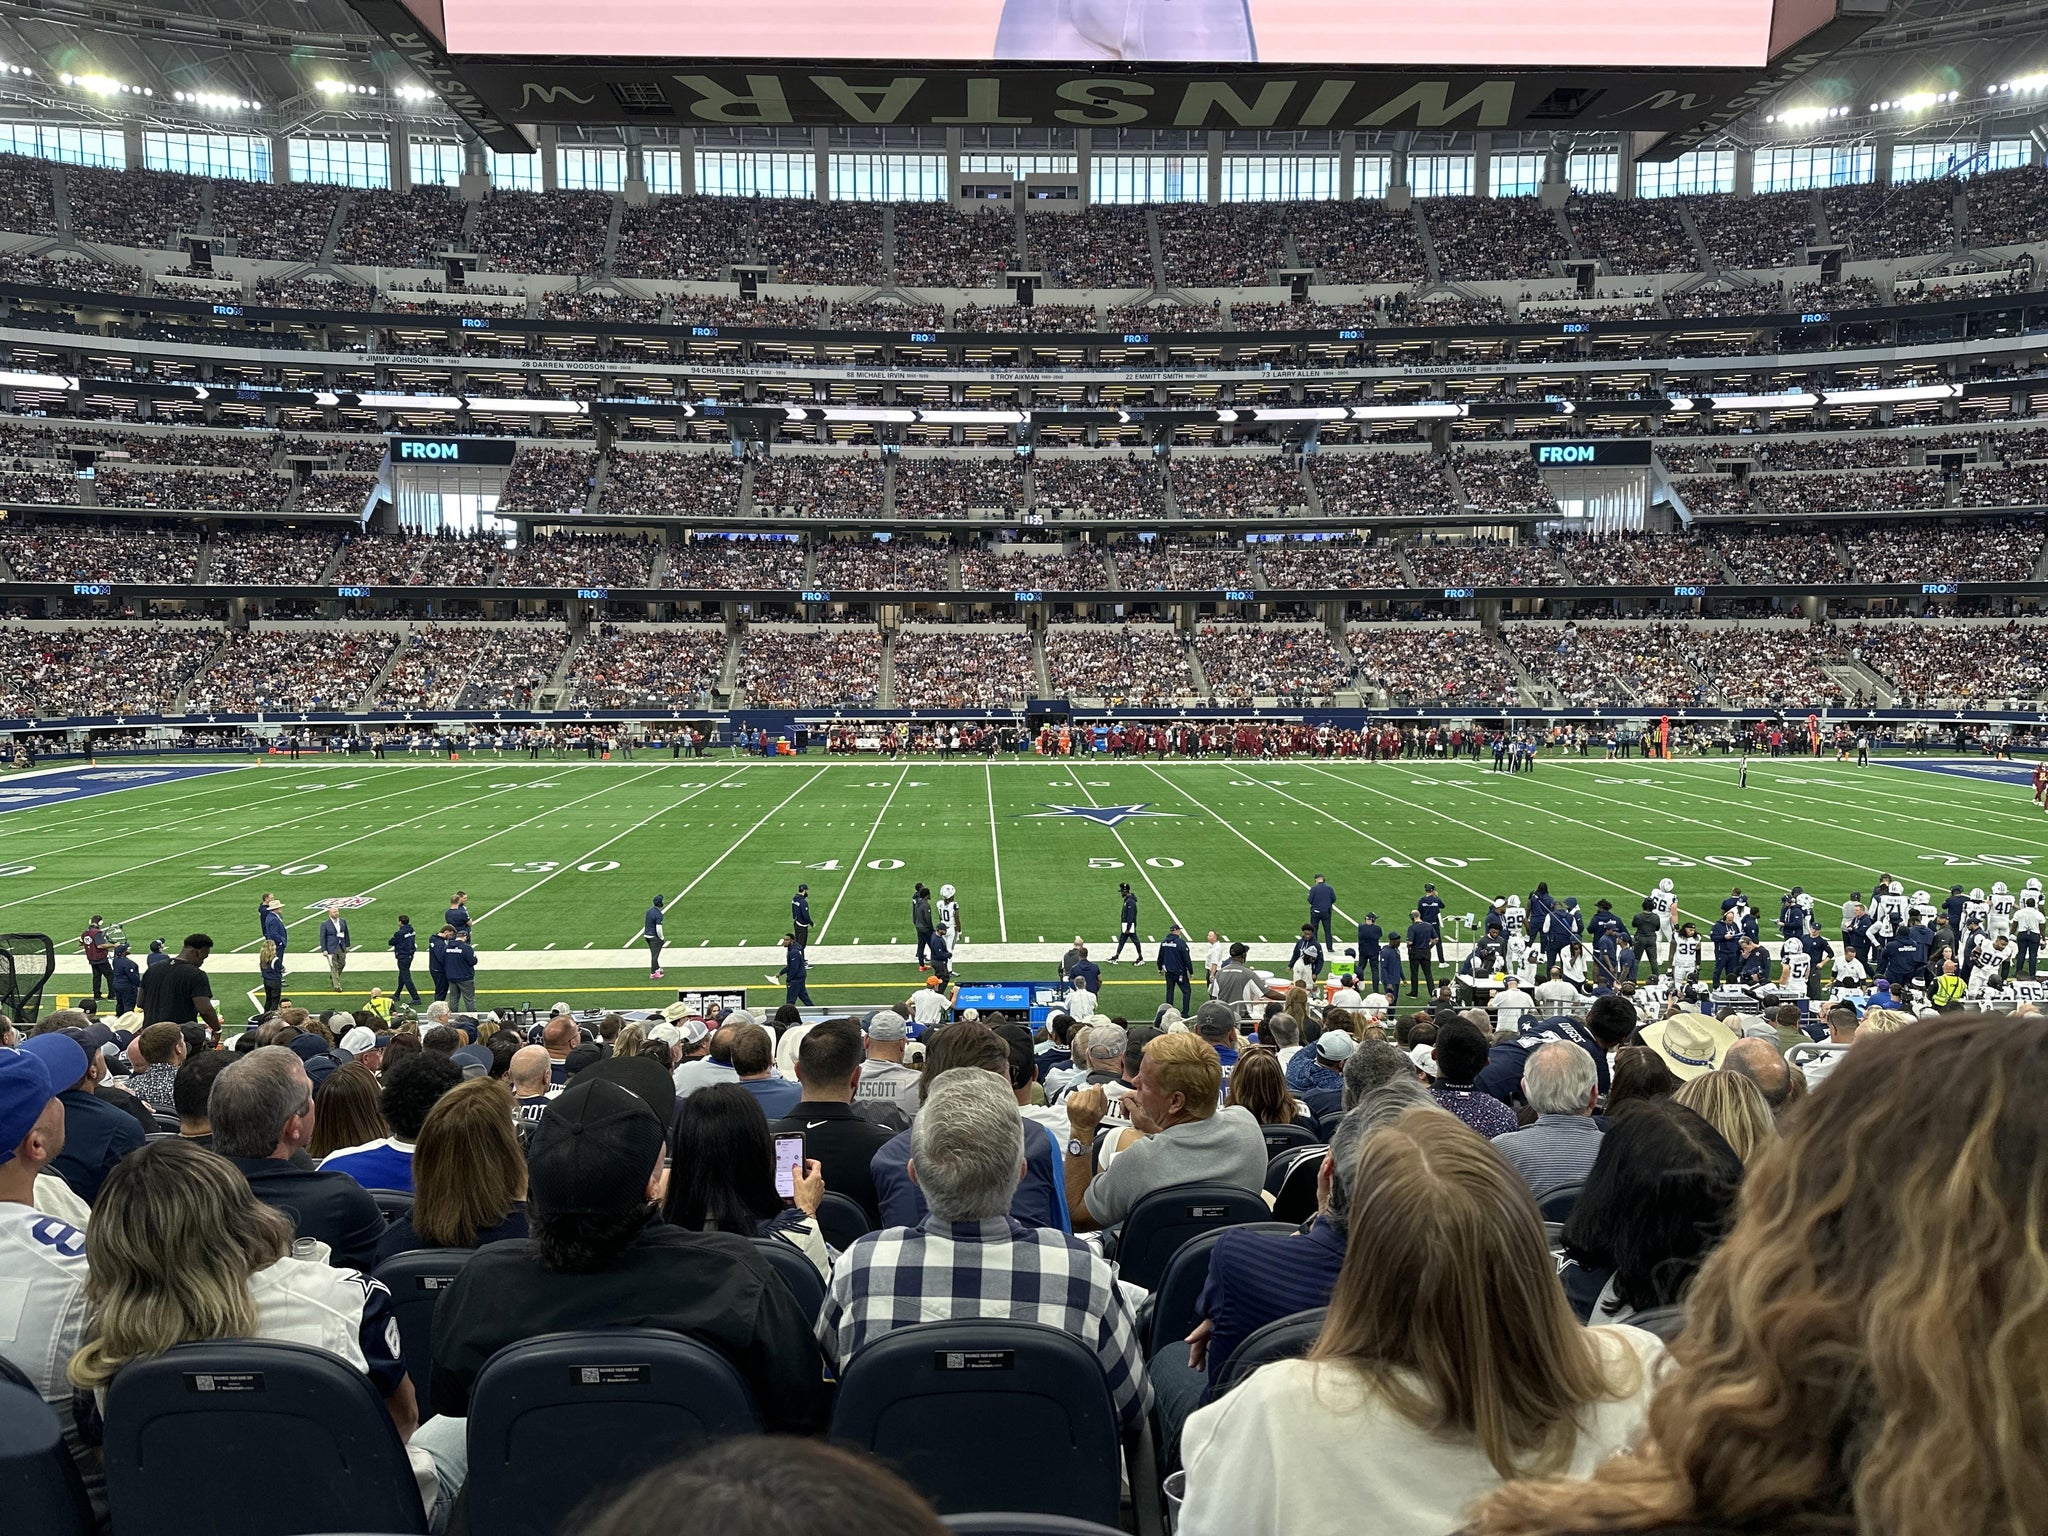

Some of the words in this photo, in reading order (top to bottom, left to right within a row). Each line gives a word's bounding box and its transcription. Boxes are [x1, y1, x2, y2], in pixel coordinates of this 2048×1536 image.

[674, 75, 1515, 127] WINSTAR
[366, 355, 390, 363] JIMMY
[391, 356, 429, 364] JOHNSON
[401, 442, 459, 459] FROM
[1539, 446, 1595, 462] FROM
[510, 860, 621, 872] 30
[804, 859, 906, 870] 40
[1087, 857, 1185, 868] 50
[1370, 856, 1469, 868] 40
[1995, 902, 2012, 914] 40
[1507, 915, 1524, 929] 29
[1679, 943, 1696, 955] 35
[1982, 952, 2003, 967] 90
[2020, 986, 2041, 1000] 95
